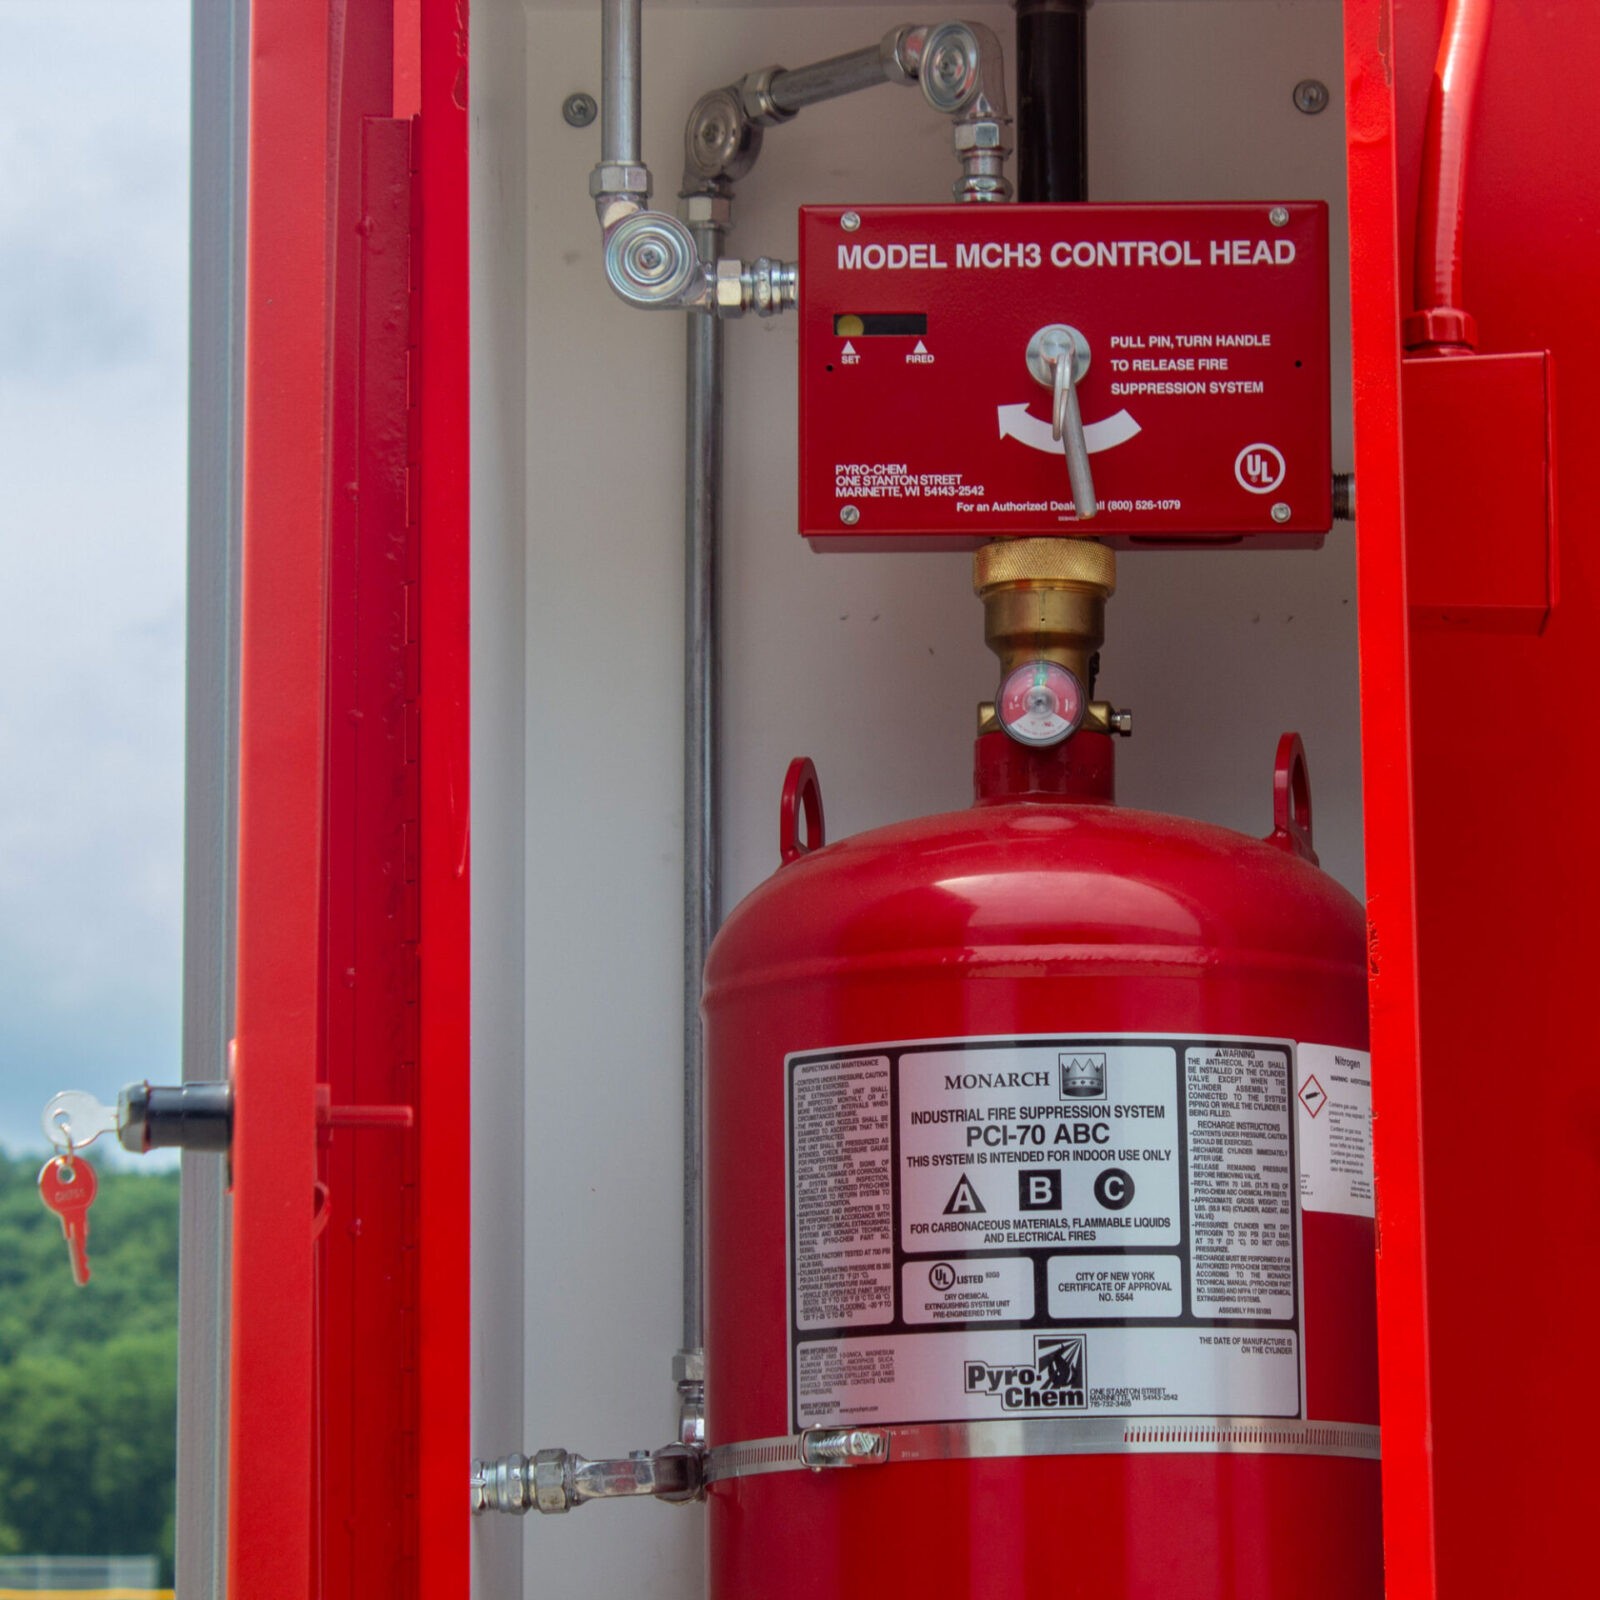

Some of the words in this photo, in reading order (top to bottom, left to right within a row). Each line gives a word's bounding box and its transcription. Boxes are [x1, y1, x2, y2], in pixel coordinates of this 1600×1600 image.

[838, 244, 948, 269] MODEL
[956, 243, 1042, 268] MCH3
[1050, 240, 1201, 268] CONTROL
[1210, 240, 1296, 266] HEAD
[1111, 336, 1145, 348] PULL
[1149, 336, 1173, 349] PIN,
[1176, 335, 1212, 346] TURN
[1216, 335, 1270, 346] HANDLE
[842, 356, 860, 364] SET
[906, 355, 934, 364] FIRED
[1111, 360, 1129, 371] TO
[1133, 359, 1194, 370] RELEASE
[1198, 358, 1228, 370] FIRE
[1111, 382, 1206, 394] SUPPRESSION
[1210, 381, 1263, 393] SYSTEM
[836, 464, 907, 475] PYRO-CHEM
[836, 475, 860, 486] ONE
[863, 475, 918, 486] STANTON
[920, 474, 962, 485] STREET
[836, 486, 902, 498] MARINETTE,
[905, 486, 919, 496] WI
[924, 486, 984, 496] 54143-2542
[956, 502, 974, 512] For
[976, 504, 989, 512] an
[992, 501, 1048, 511] Authorized
[1108, 500, 1133, 512] (800)
[1135, 500, 1181, 510] 526-1079
[1223, 1050, 1255, 1058] WARNING
[1268, 1061, 1285, 1069] SHALL
[1334, 1056, 1360, 1070] Nitrogen
[944, 1071, 1050, 1090] MONARCH
[1236, 1085, 1268, 1093] ASSEMBLY
[1189, 1092, 1228, 1100] CONNECTED
[1189, 1100, 1209, 1108] PIPING
[911, 1110, 984, 1125] INDUSTRIAL
[988, 1107, 1016, 1120] FIRE
[1019, 1106, 1110, 1120] SUPPRESSION
[1114, 1105, 1165, 1119] SYSTEM
[1198, 1121, 1235, 1129] RECHARGE
[966, 1125, 1045, 1147] PCI-70
[1053, 1122, 1110, 1145] ABC
[907, 1156, 930, 1167] THIS
[932, 1154, 975, 1166] SYSTEM
[977, 1153, 987, 1164] IS
[990, 1151, 1044, 1164] INTENDED
[1047, 1151, 1070, 1162] FOR
[1072, 1150, 1115, 1162] INDOOR
[1118, 1150, 1140, 1161] USE
[1142, 1150, 1171, 1161] ONLY
[951, 1183, 976, 1212] A
[1029, 1176, 1052, 1204] B
[1104, 1177, 1125, 1201] C
[910, 1224, 930, 1234] FOR
[931, 1219, 1011, 1233] CARBONACEOUS
[1013, 1218, 1070, 1230] MATERIALS,
[1072, 1218, 1132, 1228] FLAMMABLE
[1134, 1218, 1170, 1228] LIQUIDS
[984, 1233, 1004, 1244] AND
[1007, 1232, 1066, 1242] ELECTRICAL
[1068, 1231, 1096, 1241] FIRES
[957, 1275, 983, 1284] LISTED
[1076, 1272, 1094, 1281] CITY
[1097, 1272, 1108, 1281] OF
[1110, 1272, 1129, 1280] NEW
[1132, 1272, 1155, 1280] YORK
[1058, 1282, 1112, 1292] CERTIFICATE
[1114, 1282, 1126, 1291] OF
[1128, 1282, 1172, 1291] APPROVAL
[958, 1292, 989, 1300] CHEMICAL
[1099, 1293, 1113, 1301] NO.
[1116, 1293, 1133, 1301] 5544
[925, 1301, 969, 1310] EXTINGUISHING
[933, 1309, 984, 1318] PRE-ENGINEERED
[1242, 1338, 1286, 1346] MANUFACTURE
[1005, 1387, 1083, 1408] Chem
